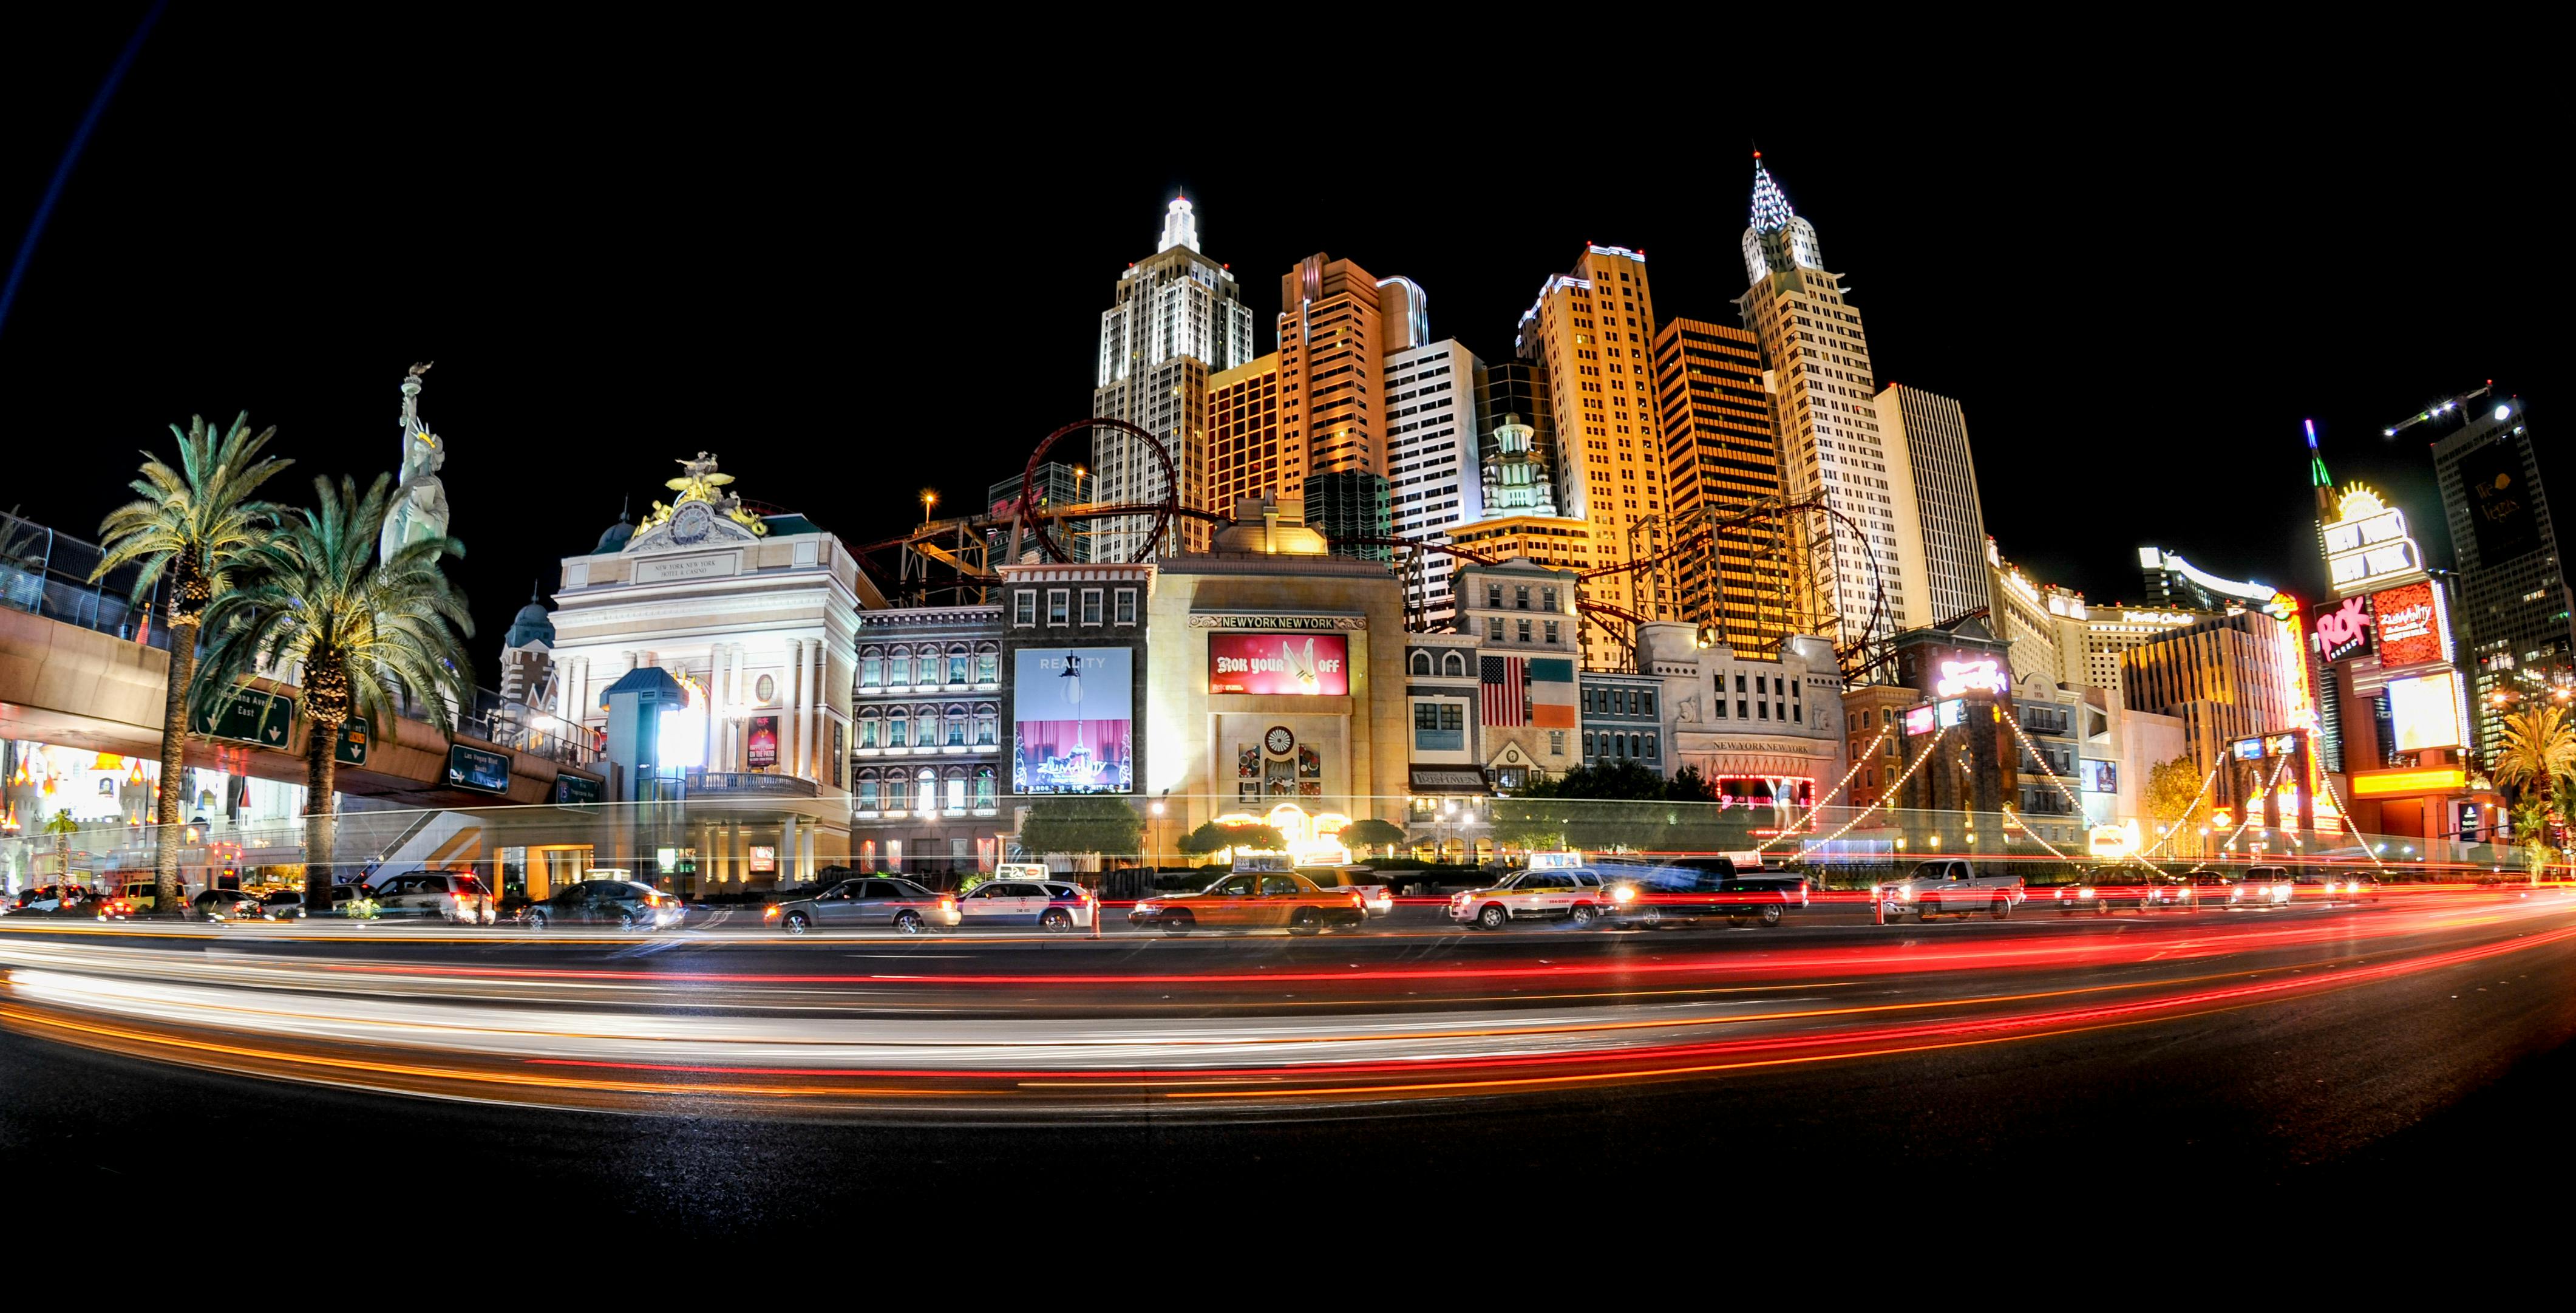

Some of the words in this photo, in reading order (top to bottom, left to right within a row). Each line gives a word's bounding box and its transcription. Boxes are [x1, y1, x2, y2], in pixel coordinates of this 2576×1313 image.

[2324, 522, 2359, 554] NEW
[2359, 513, 2402, 545] YORK
[2329, 553, 2365, 584] NEW
[2364, 543, 2411, 575] YORK
[2380, 603, 2432, 629] ZUMANITY
[2316, 596, 2371, 662] ROK
[1039, 658, 1106, 669] REALITY
[237, 705, 255, 717] East
[1738, 742, 1767, 751] YORK
[1766, 743, 1788, 752] NEW
[1788, 745, 1808, 753] YORK
[1416, 773, 1478, 784] IRISHMEN
[560, 786, 568, 798] 15
